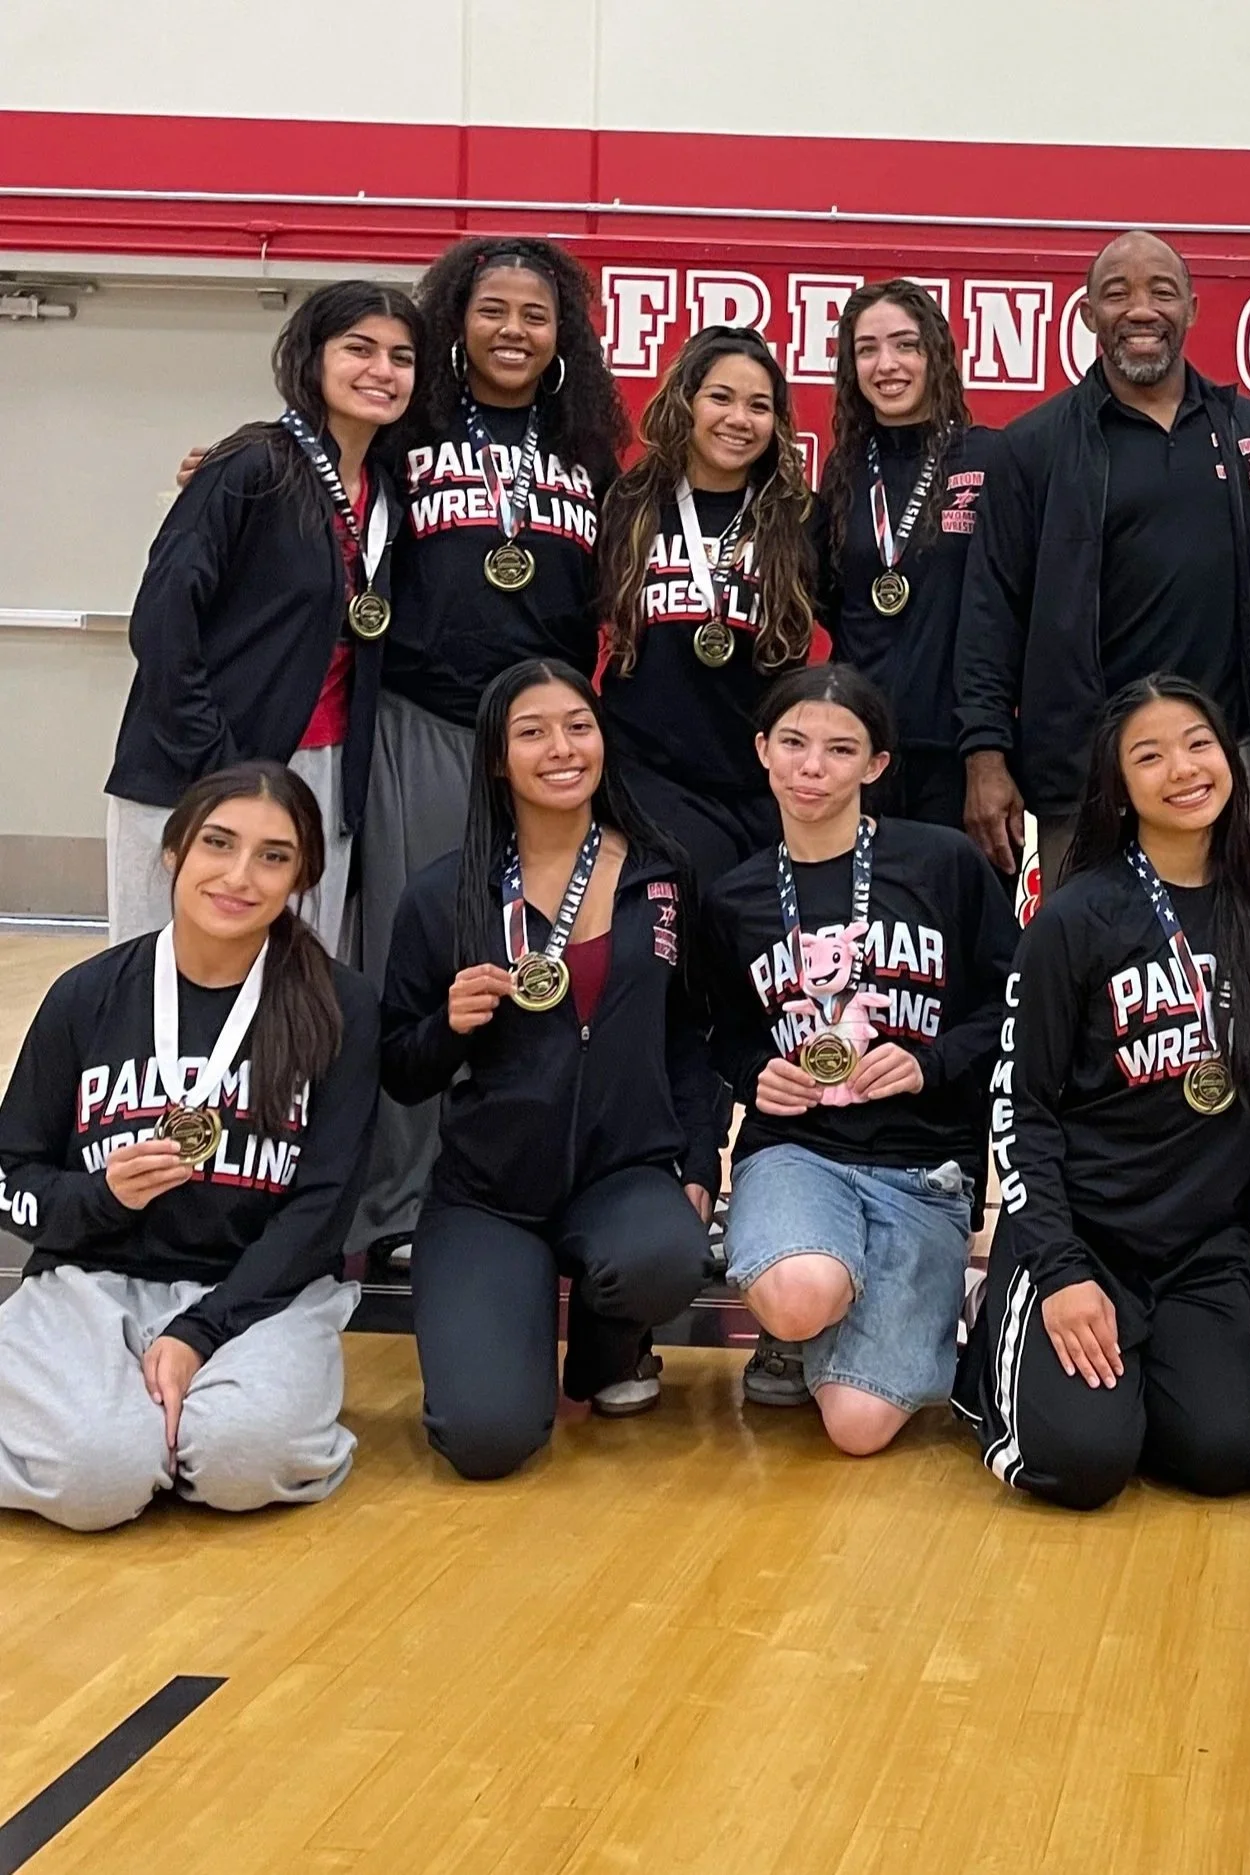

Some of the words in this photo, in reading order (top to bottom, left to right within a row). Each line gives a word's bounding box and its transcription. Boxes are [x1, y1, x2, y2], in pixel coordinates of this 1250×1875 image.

[602, 266, 1098, 393] FREN
[896, 499, 922, 539] FIRST
[560, 873, 588, 923] PLACE
[854, 881, 870, 922] LACE
[989, 972, 1028, 1214] COMETS
